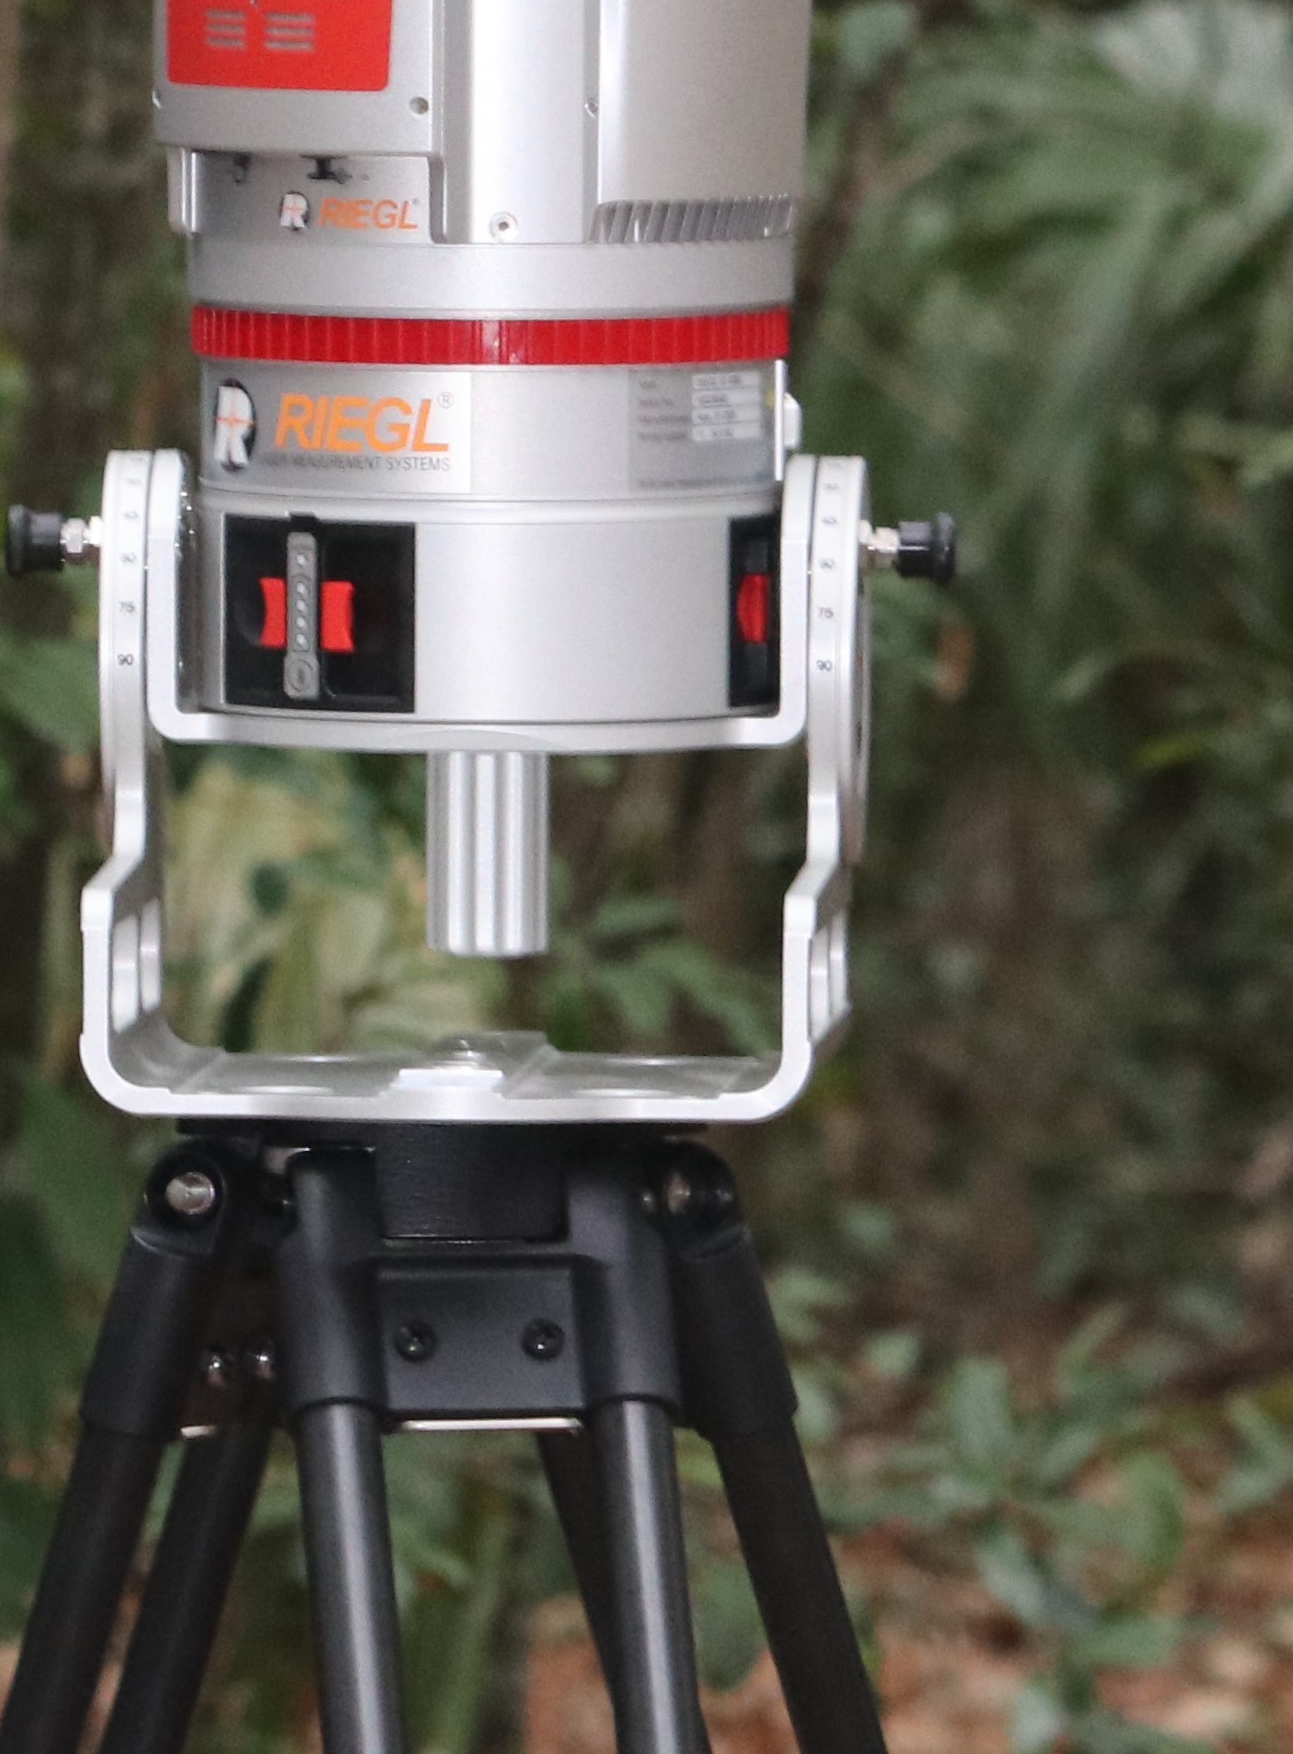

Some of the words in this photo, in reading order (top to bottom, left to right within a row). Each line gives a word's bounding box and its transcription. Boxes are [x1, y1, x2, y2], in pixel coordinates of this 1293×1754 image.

[318, 197, 418, 230] RIEGL
[274, 392, 449, 453] RIEGL
[386, 455, 451, 472] SYSTEMS
